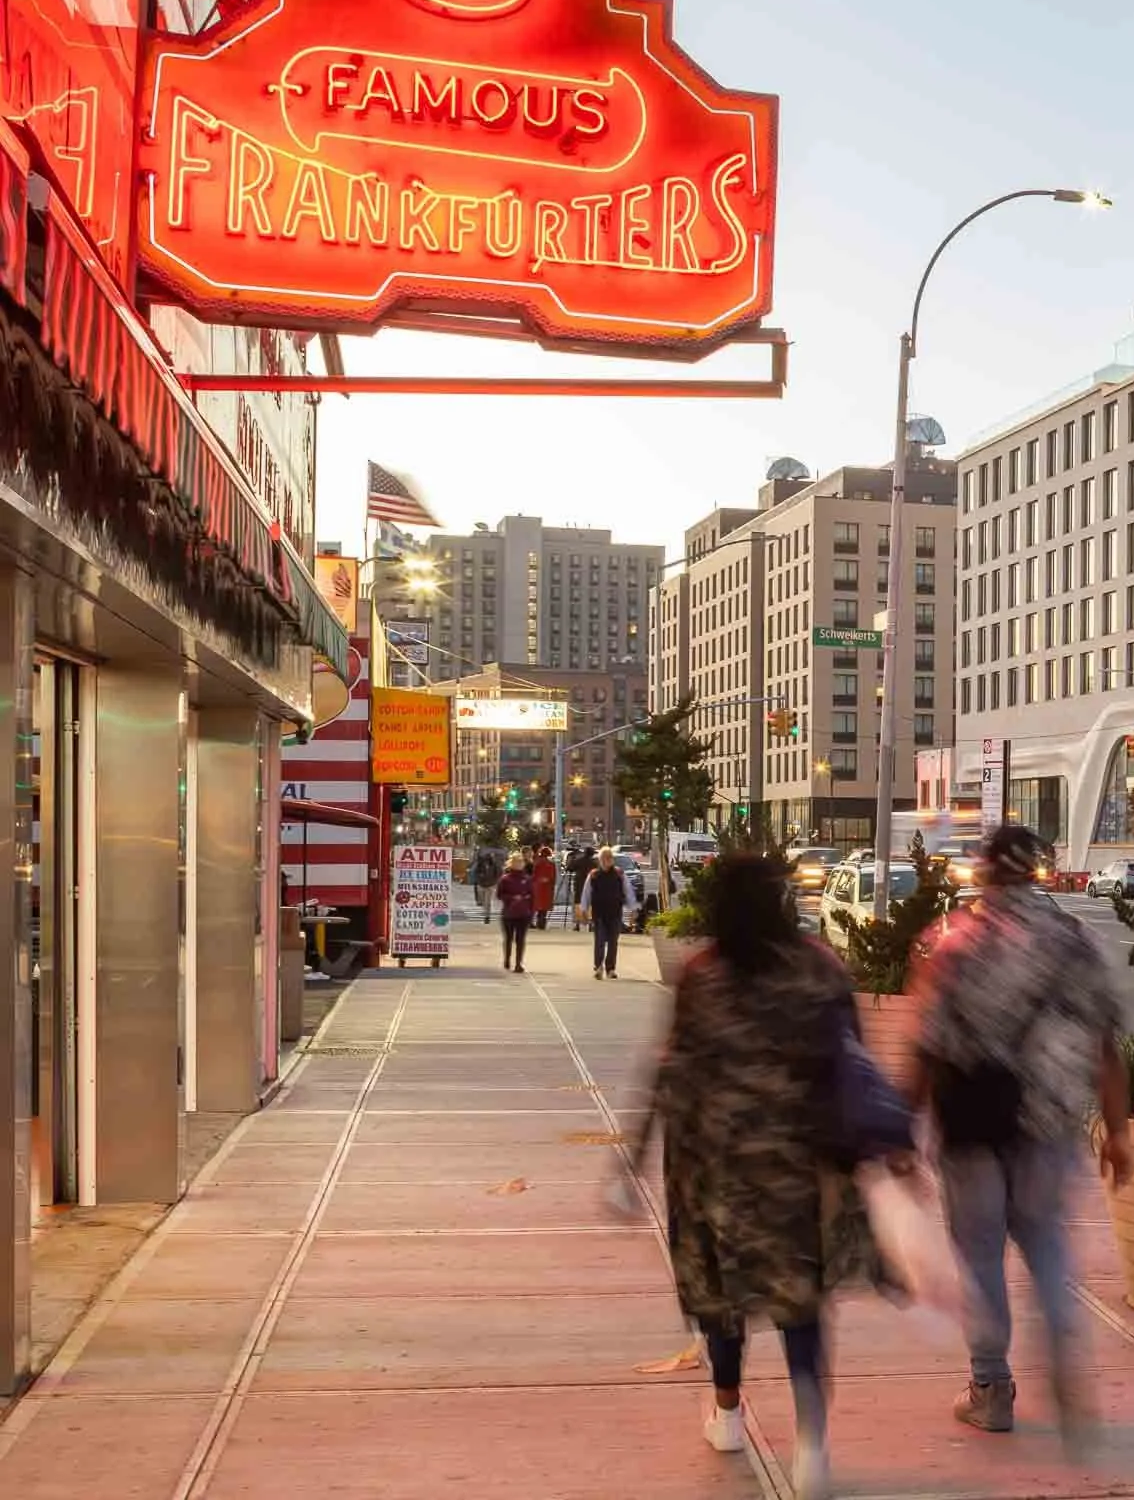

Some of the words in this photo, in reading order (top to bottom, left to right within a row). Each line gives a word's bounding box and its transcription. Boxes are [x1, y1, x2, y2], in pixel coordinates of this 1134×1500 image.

[324, 60, 610, 139] FAMOUS
[165, 94, 750, 277] FRANKFURTERS
[401, 848, 447, 862] ATM
[397, 883, 449, 892] MILKSHAKES
[415, 892, 448, 901] CANDY
[411, 901, 449, 909] APPLES
[396, 909, 429, 919] COTTON
[395, 920, 425, 930] CANDY
